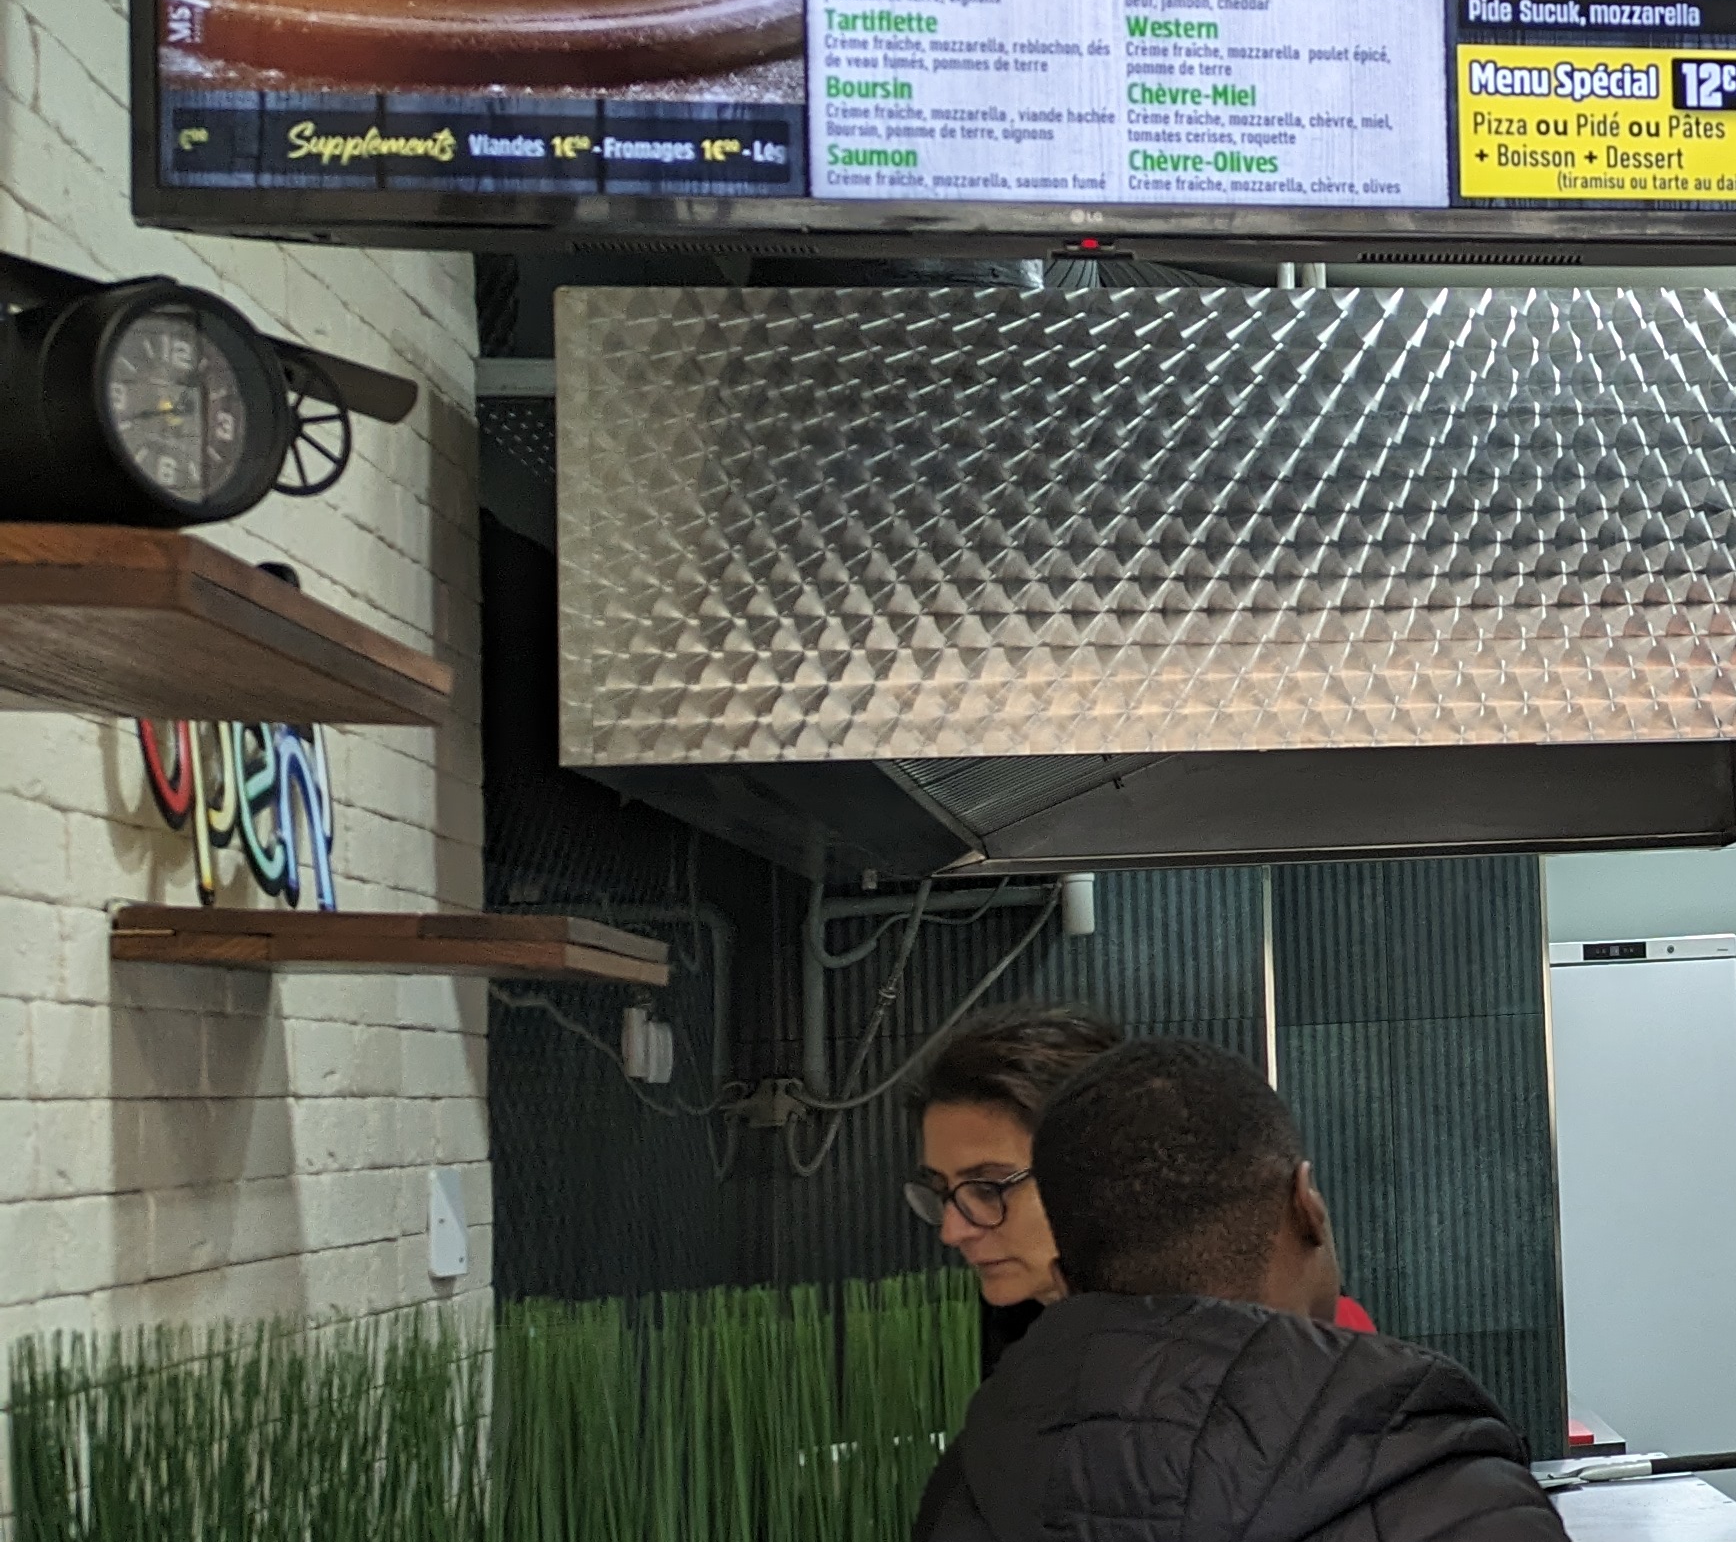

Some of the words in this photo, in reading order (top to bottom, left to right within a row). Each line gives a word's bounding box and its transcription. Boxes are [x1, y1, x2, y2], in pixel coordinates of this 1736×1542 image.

[825, 9, 938, 34] Tartiflette
[1519, 0, 1587, 27] Sucuk,
[1590, 2, 1701, 27] mozzarella
[1127, 17, 1218, 40] Western
[826, 76, 913, 100] Boursin
[1470, 61, 1549, 96] Menu
[1555, 64, 1659, 101] Spécial
[1127, 83, 1257, 108] Chèvre-Miel
[1473, 113, 1528, 136] Pizza
[1536, 122, 1568, 137] ou
[1577, 114, 1620, 138] Pidé
[1628, 123, 1661, 138] ou
[1668, 114, 1725, 139] Pâtes
[468, 133, 545, 157] Viandes
[604, 136, 695, 163] Fromages
[827, 144, 918, 169] Saumon
[1475, 149, 1489, 163] +
[1497, 145, 1575, 168] Boisson
[1584, 150, 1598, 164] +
[1607, 147, 1684, 169] Dessert
[1129, 149, 1278, 175] Chèvre-Olives
[1557, 173, 1626, 192] (tiramisu
[1630, 178, 1647, 190] ou
[1651, 176, 1689, 190] tarte
[1694, 179, 1712, 191] au
[216, 411, 234, 441] 3
